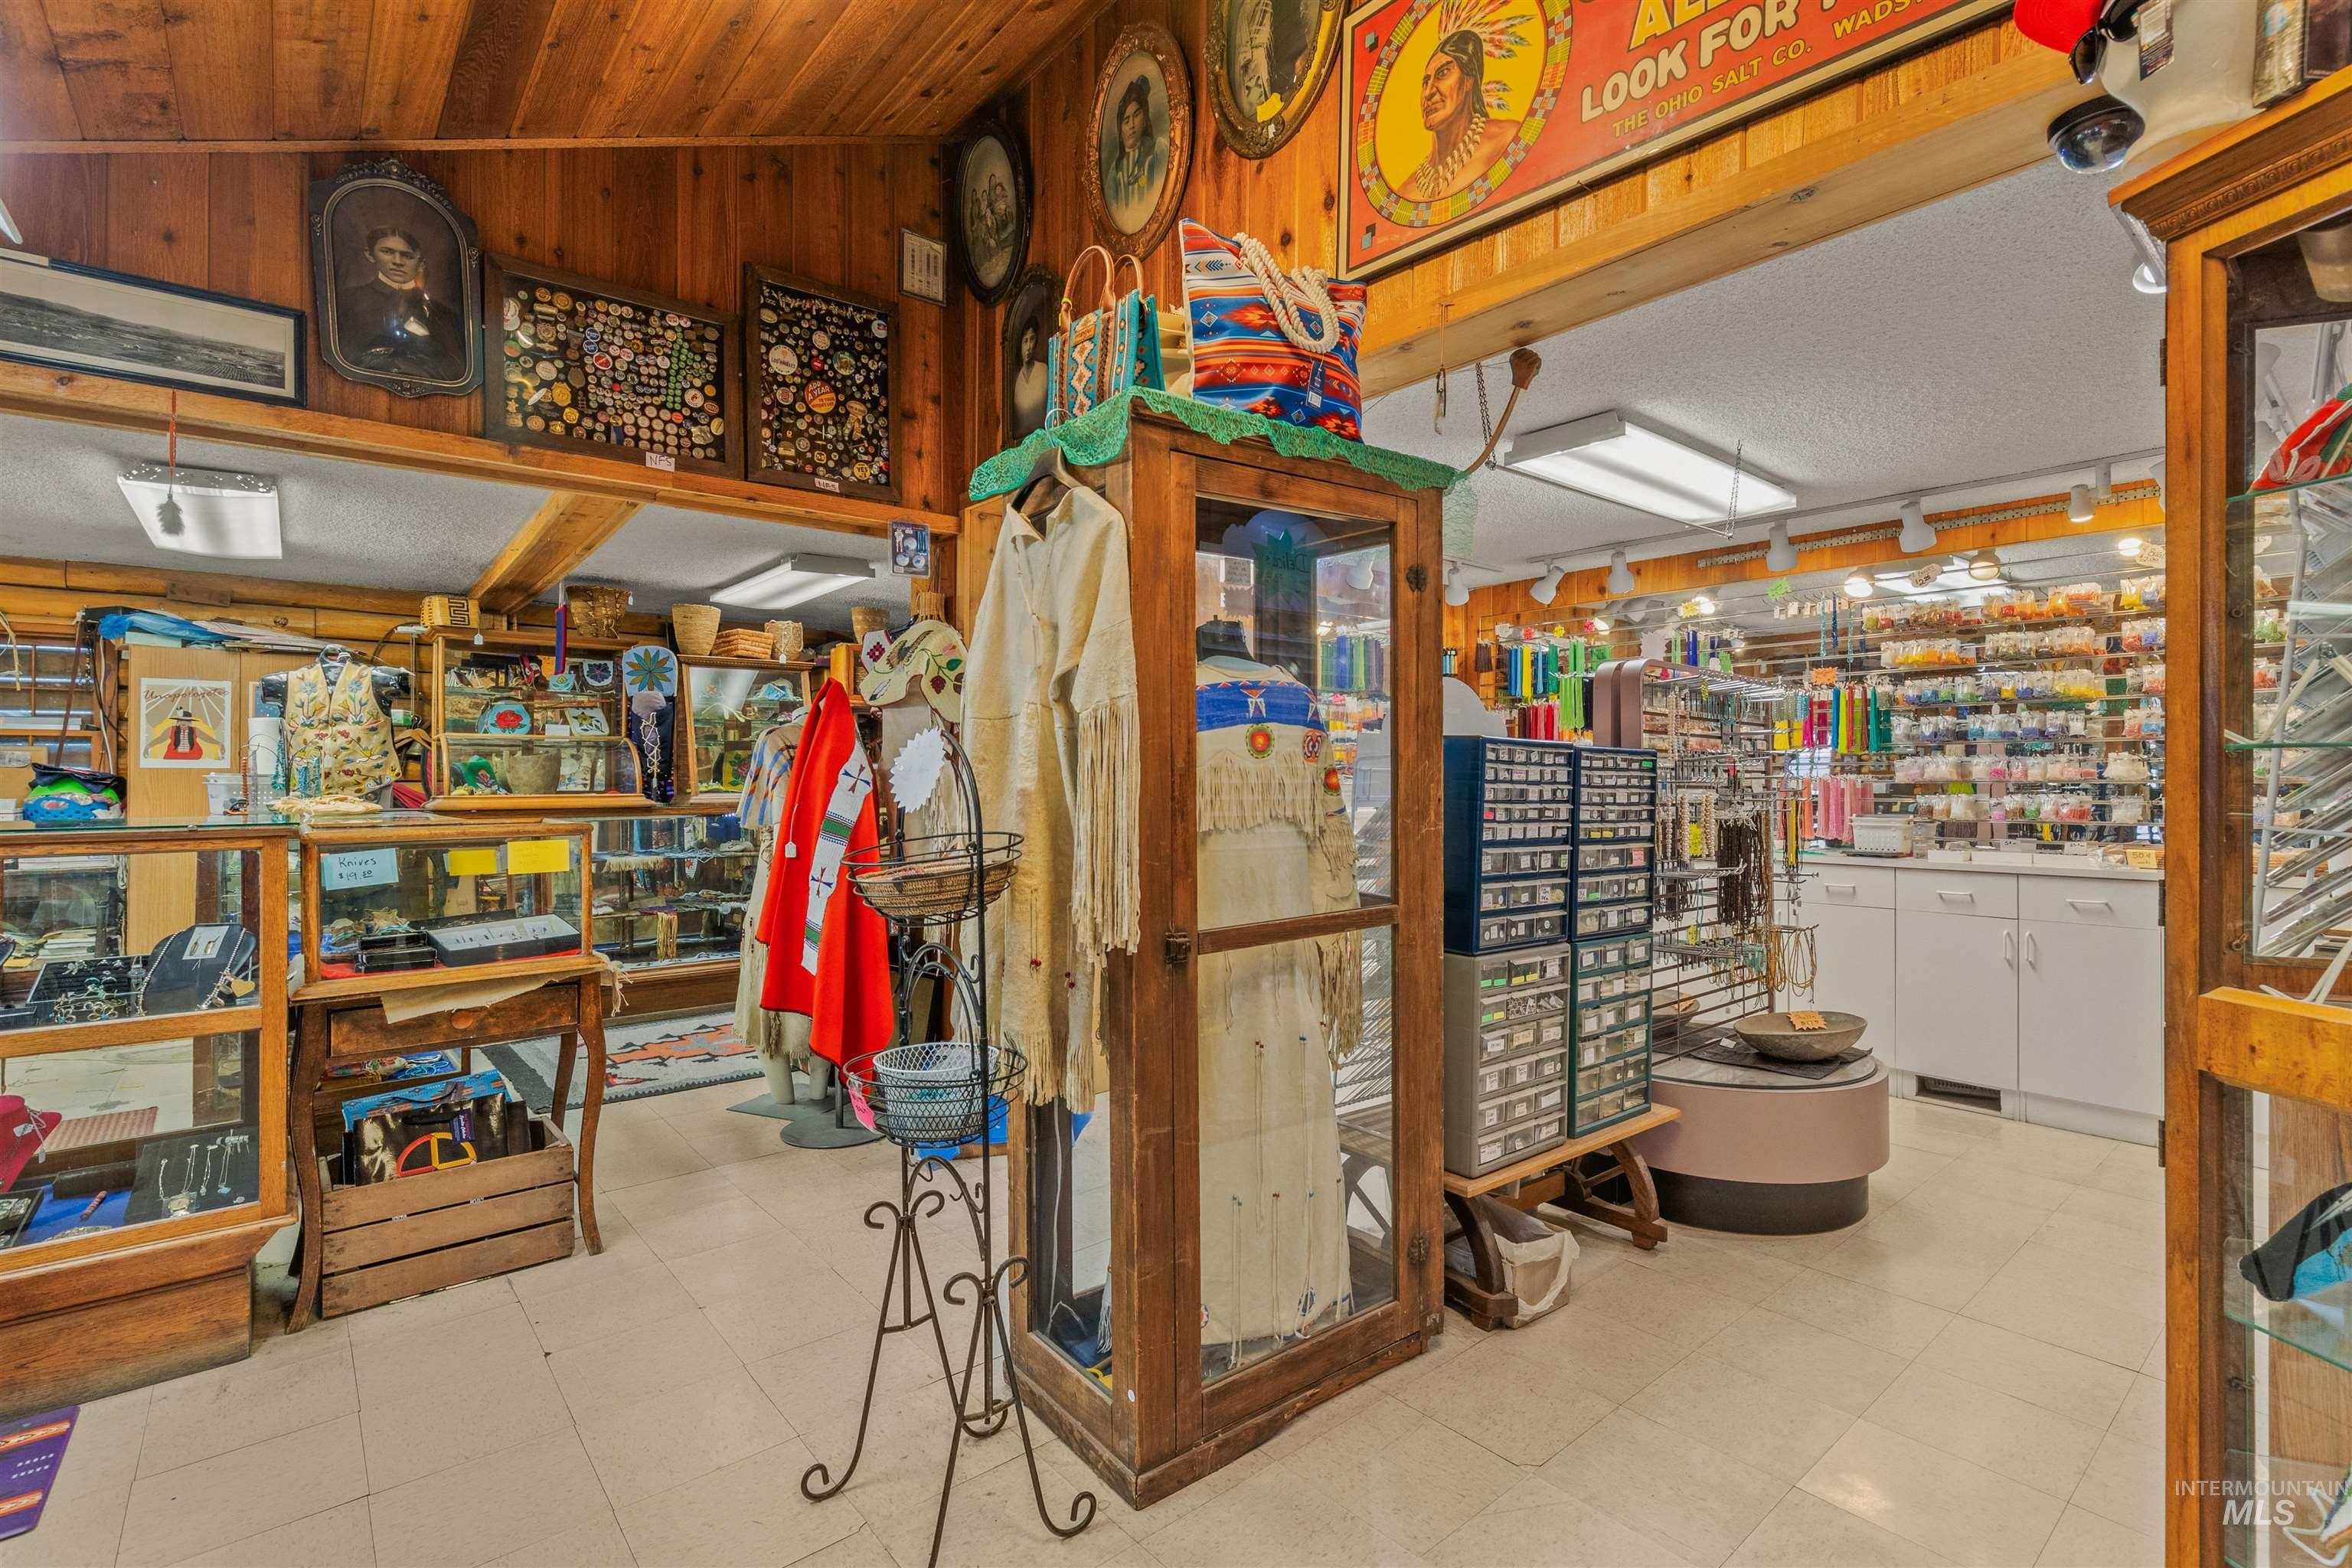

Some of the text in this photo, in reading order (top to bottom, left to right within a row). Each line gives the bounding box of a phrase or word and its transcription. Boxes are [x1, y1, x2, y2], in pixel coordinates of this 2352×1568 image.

[1580, 0, 1799, 124] LOOK FOR
[1612, 109, 1648, 138] THE
[1655, 84, 1703, 119] OHIO
[1711, 57, 1762, 94] SALT
[1771, 38, 1812, 67] CO.
[808, 381, 821, 391] ADD
[808, 385, 830, 401] A YEAR
[648, 455, 672, 467] NFS
[142, 687, 230, 702] Unapologetic
[338, 858, 377, 867] Knives
